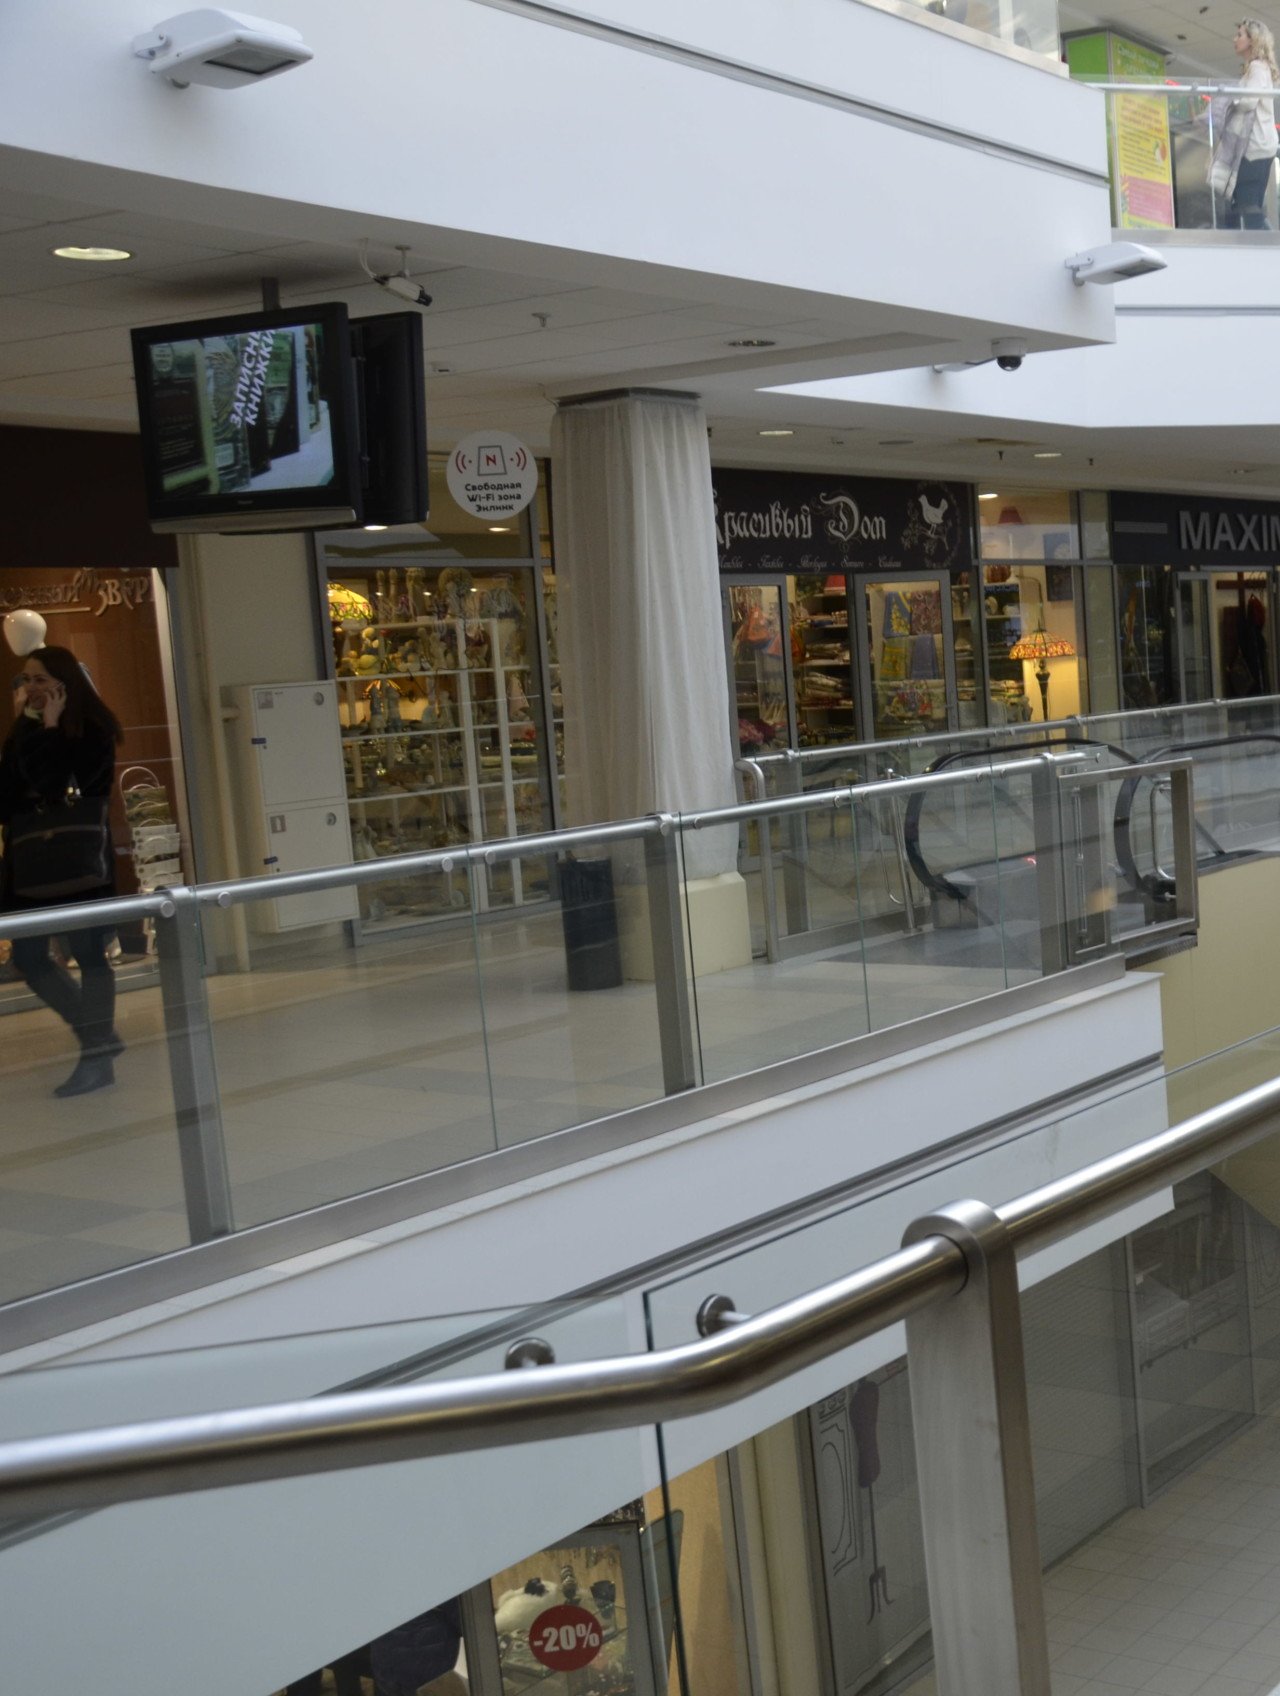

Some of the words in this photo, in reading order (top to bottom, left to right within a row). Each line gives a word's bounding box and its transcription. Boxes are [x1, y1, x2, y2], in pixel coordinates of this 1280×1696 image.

[464, 482, 522, 492] Свободная
[467, 494, 495, 503] Wi-Fi
[498, 493, 522, 501] зона
[533, 1621, 600, 1653] -20%
